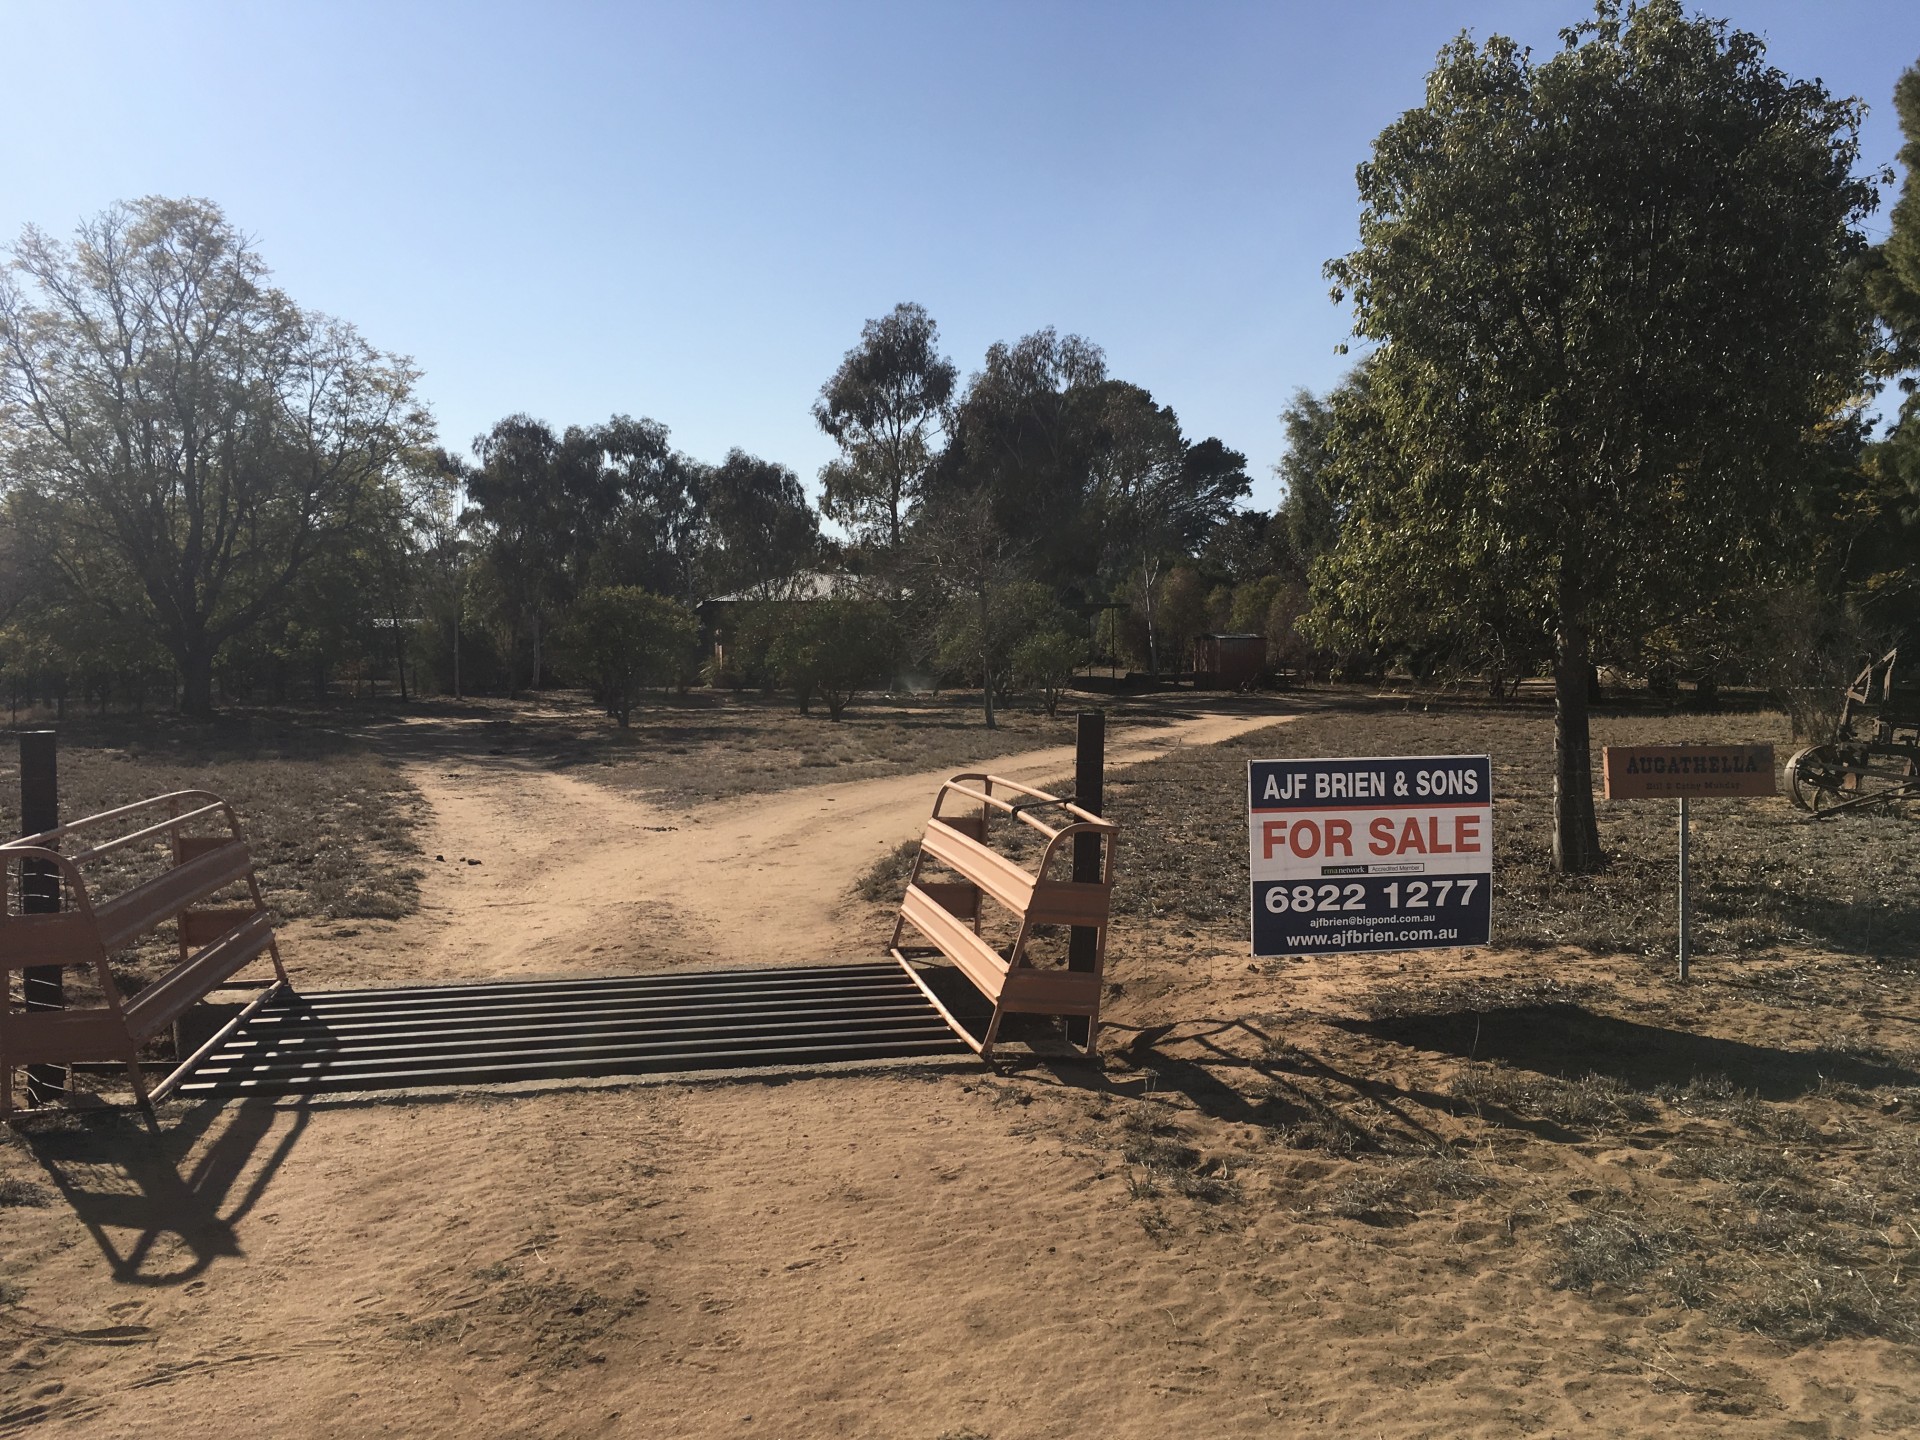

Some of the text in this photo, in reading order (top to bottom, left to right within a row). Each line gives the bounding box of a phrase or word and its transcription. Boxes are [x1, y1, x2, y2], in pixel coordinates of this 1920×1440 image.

[1626, 756, 1758, 775] AUGATHELLA
[1263, 769, 1478, 800] AJF BRIEN & SONS
[1262, 815, 1481, 860] FOR SALE
[1265, 879, 1479, 914] 6822 1277
[1310, 914, 1436, 928] ajfbrien@bigpond.com.au
[1286, 926, 1458, 947] www.ajfbrien.com.au
